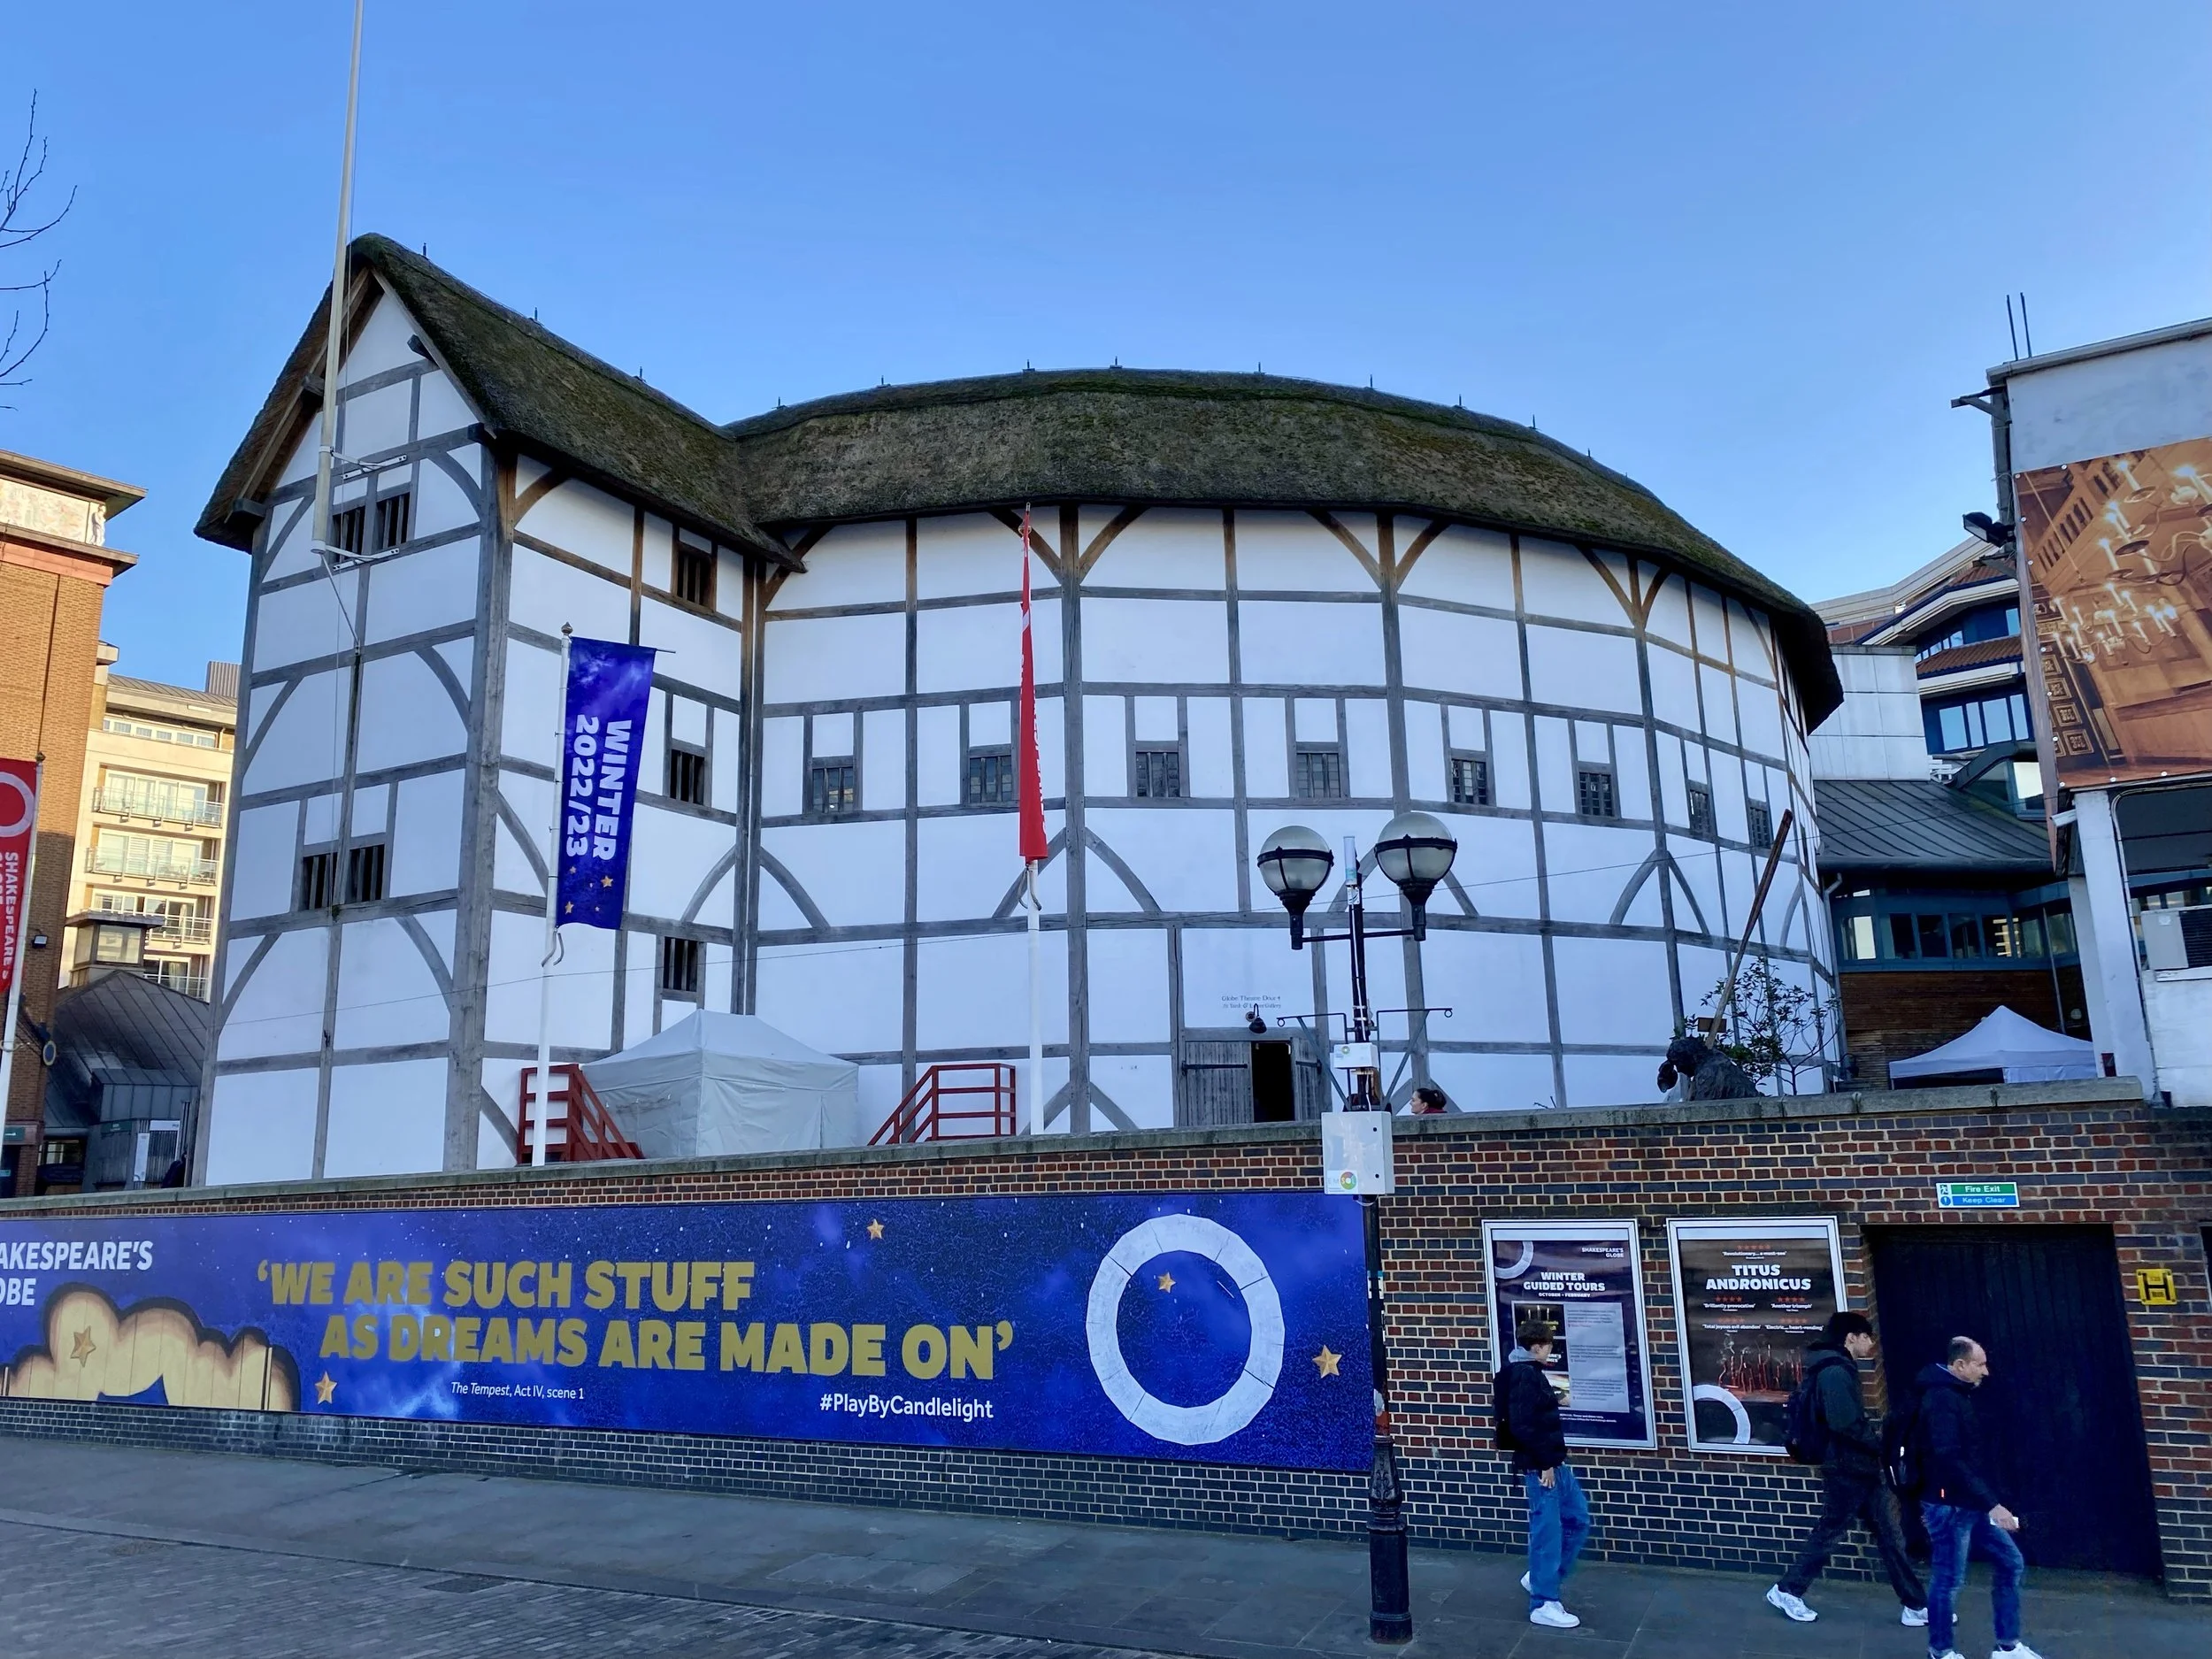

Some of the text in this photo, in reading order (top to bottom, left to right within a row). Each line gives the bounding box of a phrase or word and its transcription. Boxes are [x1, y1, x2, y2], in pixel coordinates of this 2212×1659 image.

[566, 714, 599, 857] 2022/23
[592, 718, 632, 861] WINTER
[1540, 1271, 1586, 1281] WINTER
[1732, 1264, 1781, 1276] TITUS
[343, 1261, 434, 1305] ARE
[443, 1260, 572, 1309] SUCH
[584, 1260, 755, 1311] STUFF
[1523, 1281, 1606, 1292] GUIDED TOURS
[1706, 1279, 1812, 1291] ANDRONICUS
[2141, 1272, 2171, 1301] H
[319, 1315, 378, 1360] AS
[388, 1315, 588, 1367] DREAMS
[598, 1320, 705, 1371] ARE
[720, 1322, 886, 1377] MADE
[451, 1382, 584, 1400] The Tempest, Act IV, scene 1
[819, 1393, 994, 1422] #PlayByCandlelight
